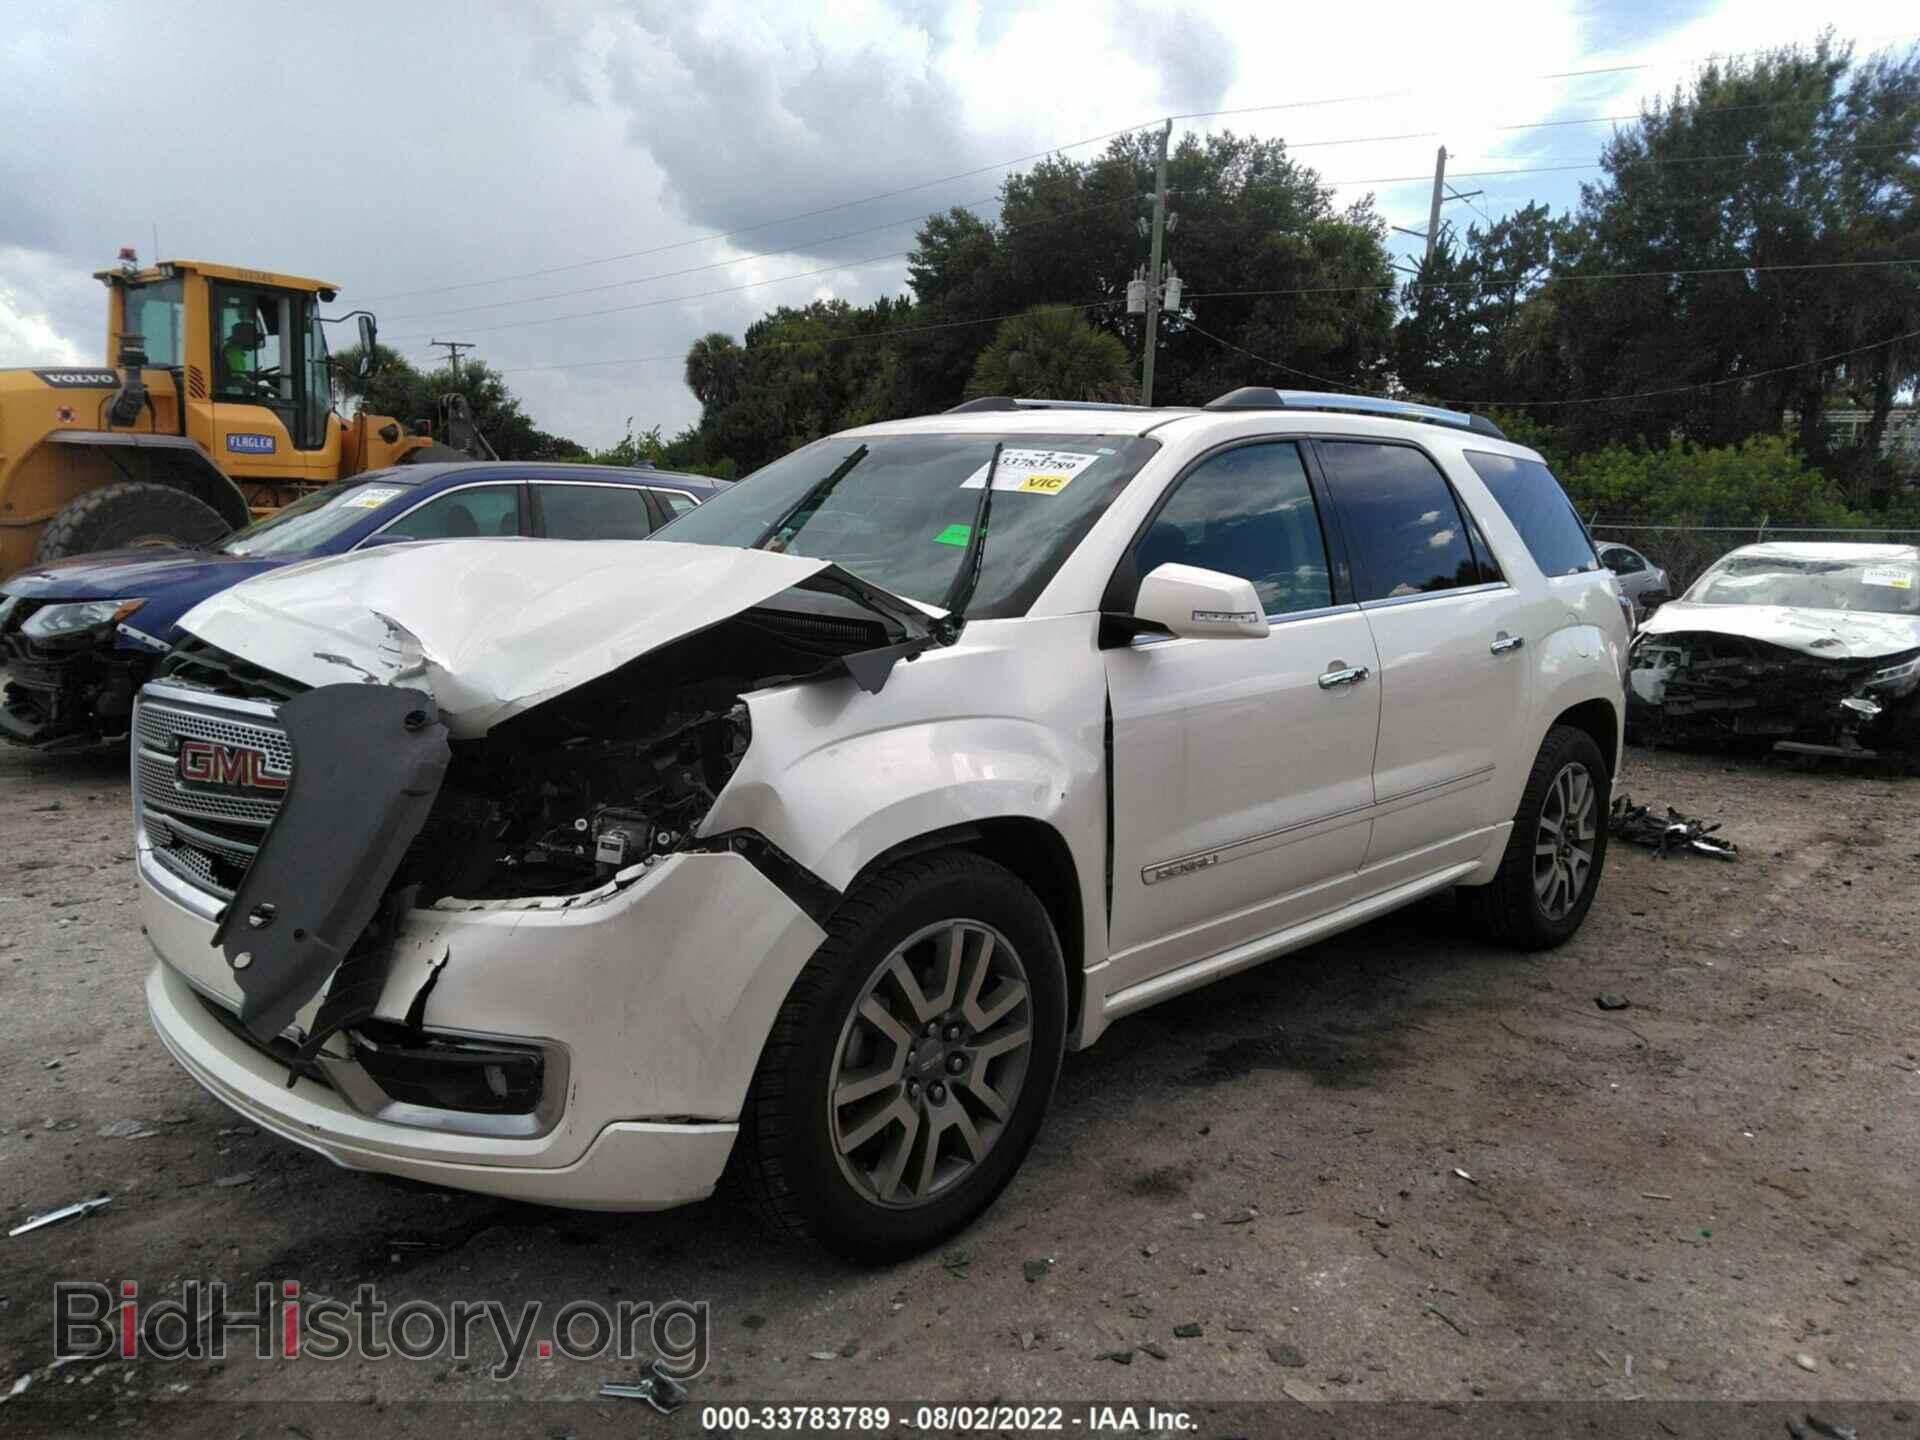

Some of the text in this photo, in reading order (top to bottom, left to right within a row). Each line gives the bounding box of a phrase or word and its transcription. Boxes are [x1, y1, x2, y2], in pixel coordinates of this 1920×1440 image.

[45, 374, 115, 384] VOLVO
[230, 436, 273, 449] FLAGLER
[1028, 477, 1062, 489] VIC
